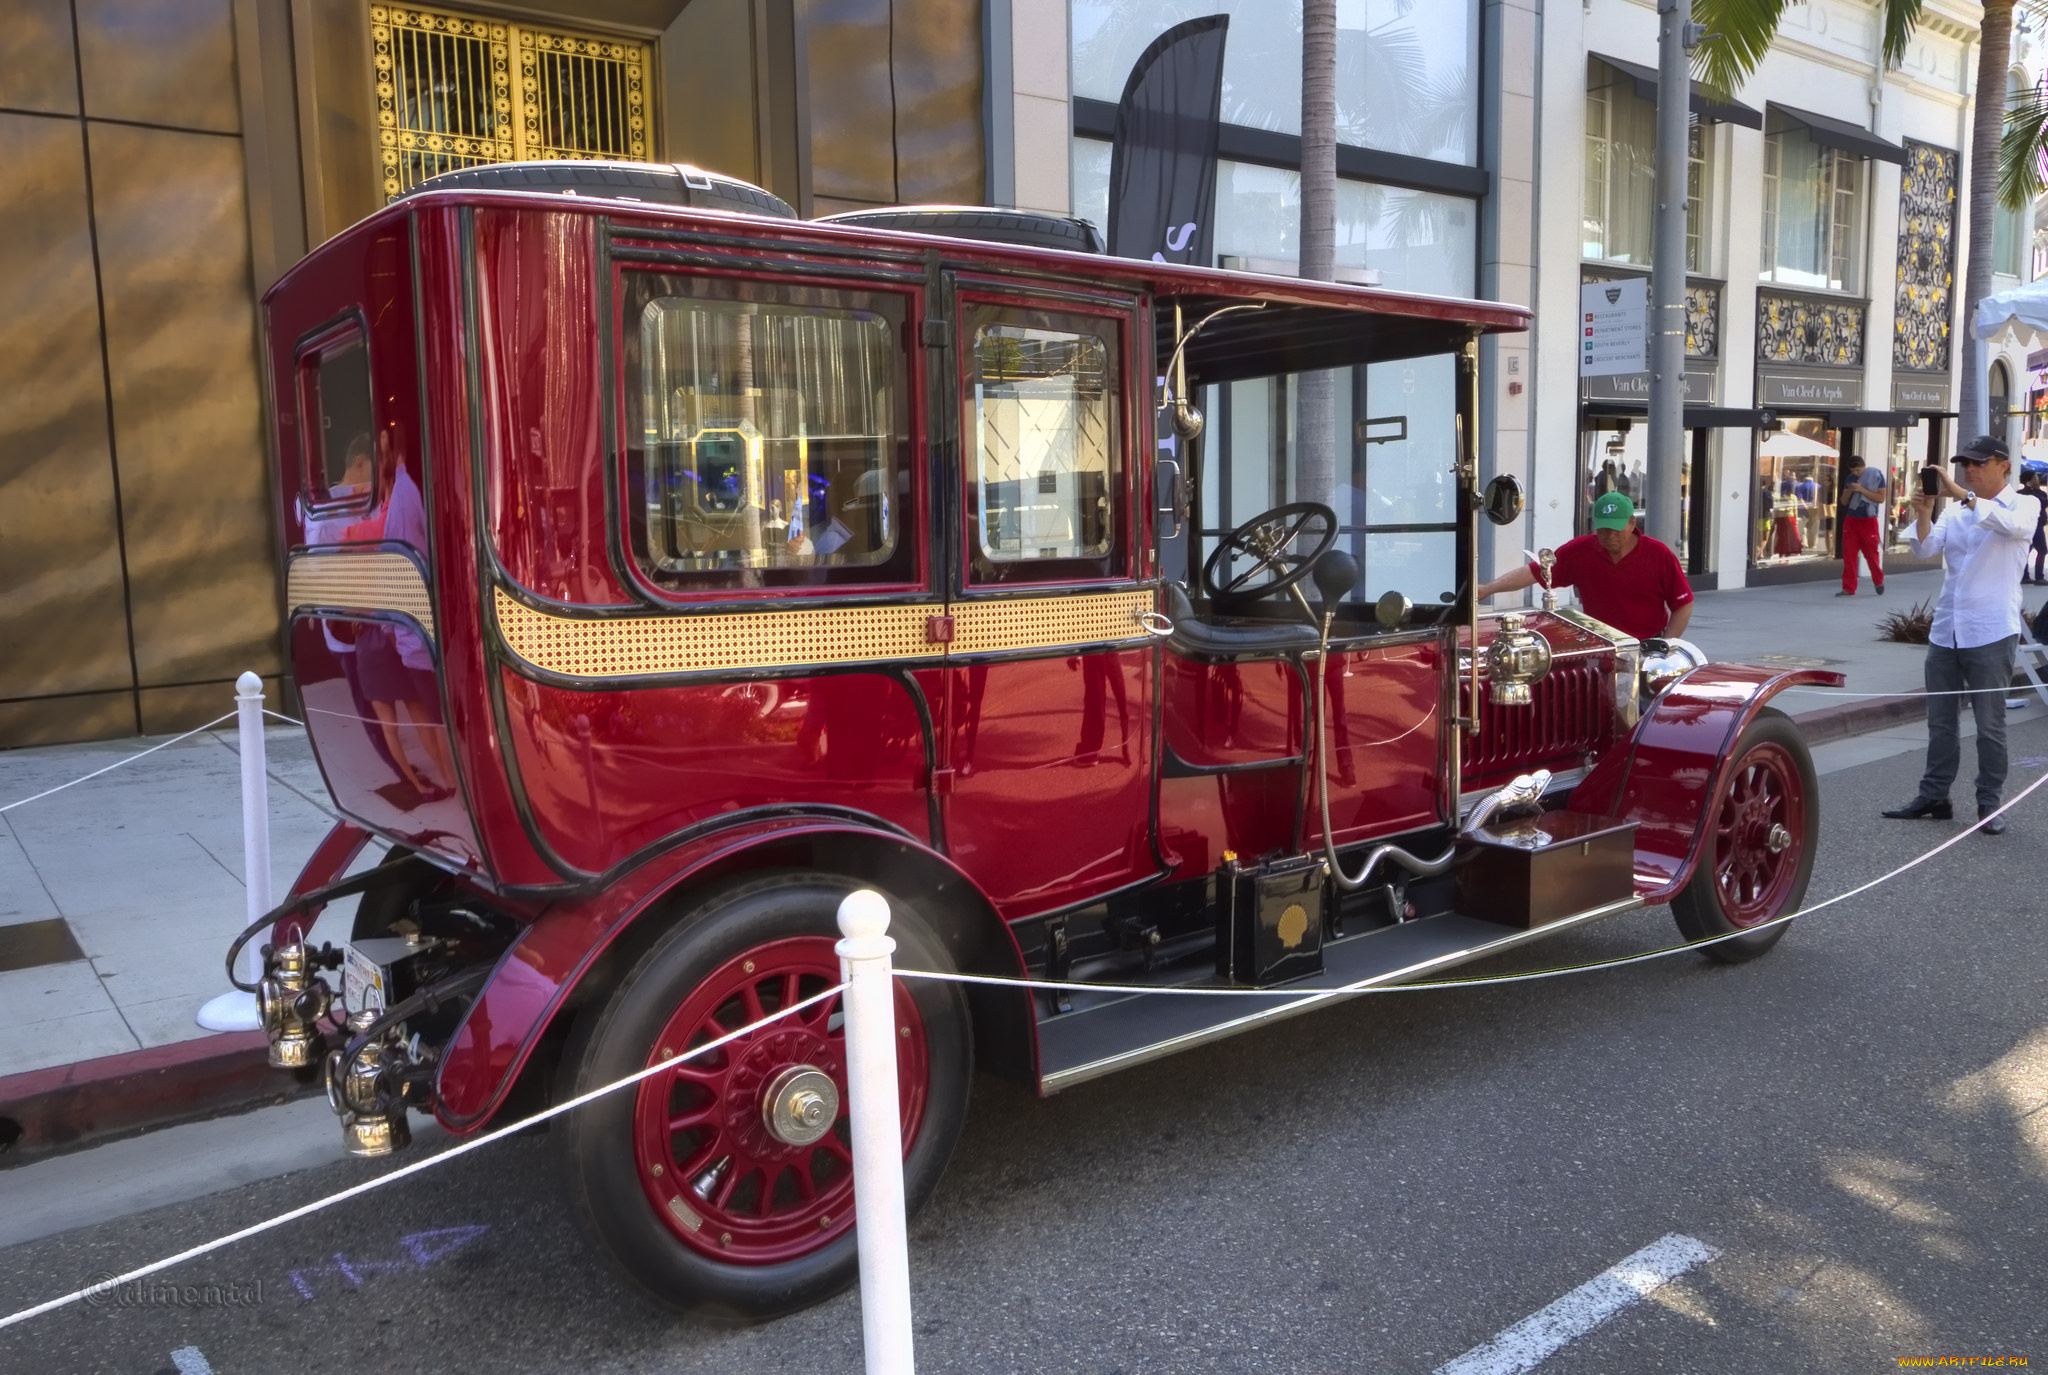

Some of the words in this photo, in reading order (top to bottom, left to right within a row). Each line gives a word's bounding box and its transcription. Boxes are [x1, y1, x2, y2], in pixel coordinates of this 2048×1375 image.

[1594, 326, 1624, 334] DEPARTMENT
[1612, 377, 1630, 392] Van
[1782, 383, 1796, 398] Van
[1796, 384, 1815, 398] Cleef
[1816, 388, 1821, 398] &
[1823, 386, 1843, 403] Arpels
